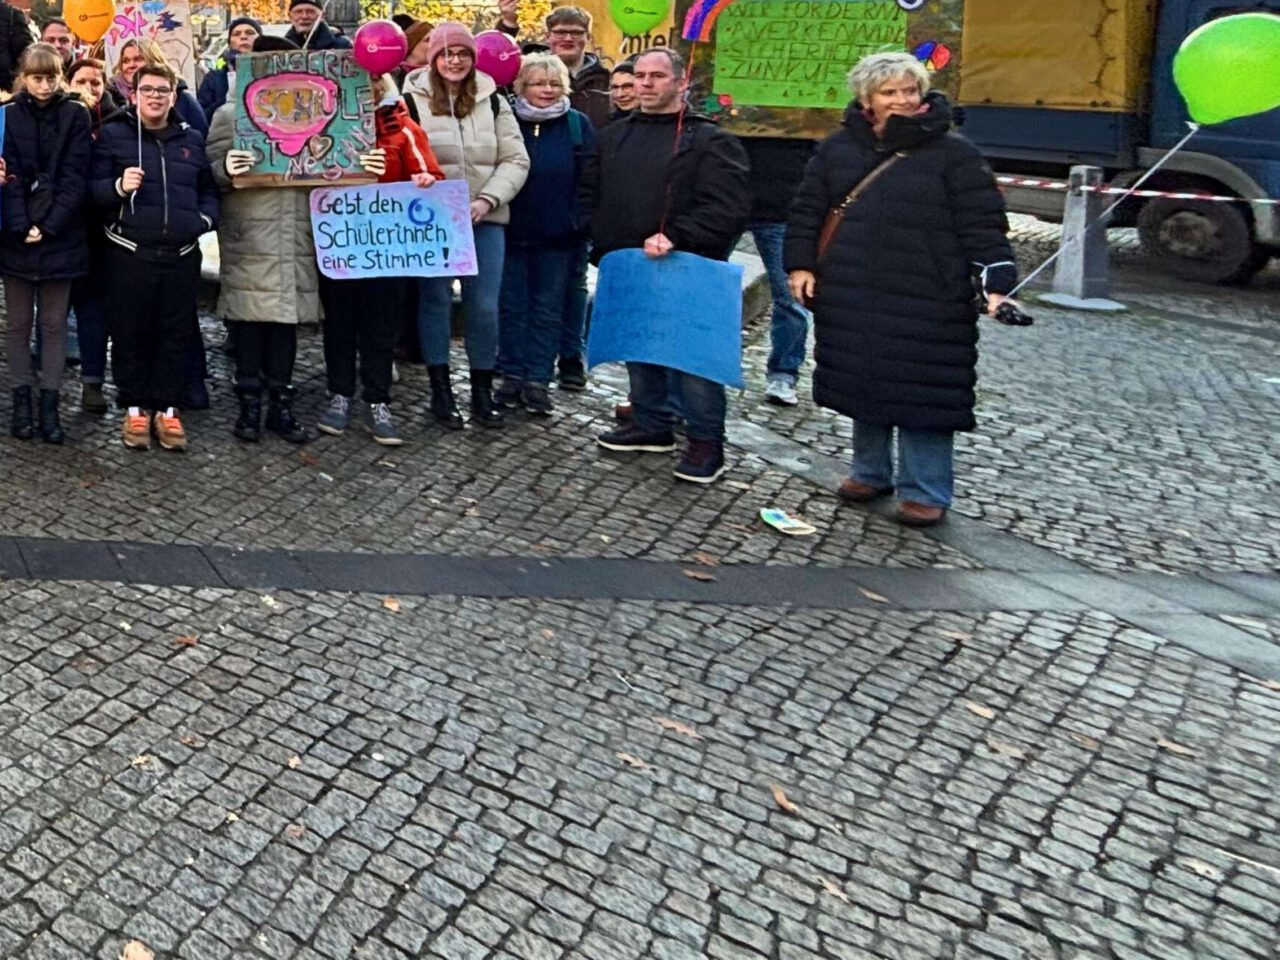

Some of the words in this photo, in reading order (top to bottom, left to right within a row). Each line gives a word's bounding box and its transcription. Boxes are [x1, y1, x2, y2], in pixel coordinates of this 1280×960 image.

[318, 191, 365, 215] Gebt
[368, 189, 404, 215] den
[318, 220, 448, 250] Schülerinnen
[322, 253, 358, 270] eine
